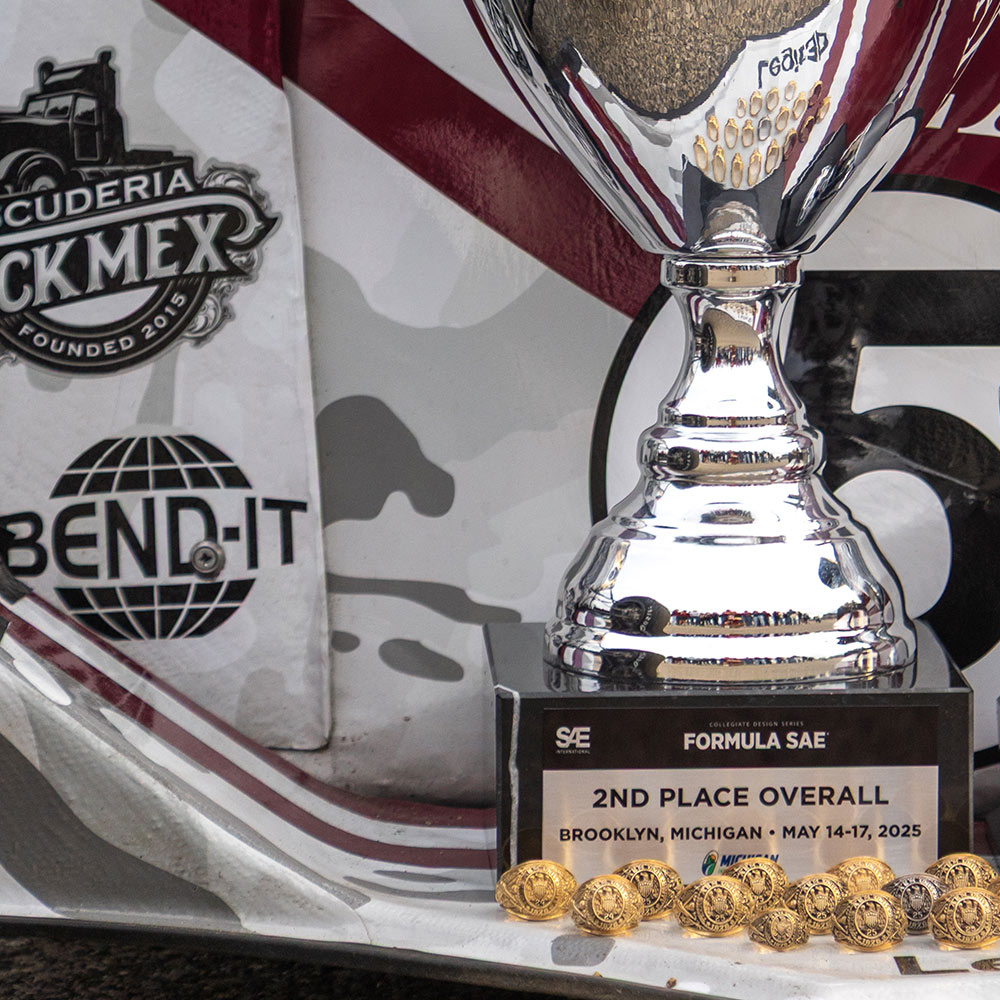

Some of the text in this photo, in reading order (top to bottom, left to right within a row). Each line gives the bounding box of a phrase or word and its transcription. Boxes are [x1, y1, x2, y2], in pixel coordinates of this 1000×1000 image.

[0, 167, 195, 228] CUDERIA
[0, 212, 229, 313] CKMEX
[17, 292, 187, 358] FOUNDED 2015
[0, 496, 308, 580] BEND-IT
[555, 726, 591, 749] SAE
[683, 731, 826, 750] FORMULA SAE
[592, 785, 889, 809] 2ND PLACE OVERALL
[559, 824, 922, 843] BROOKLYN, MICHIGAN MAY 14-17, 2025
